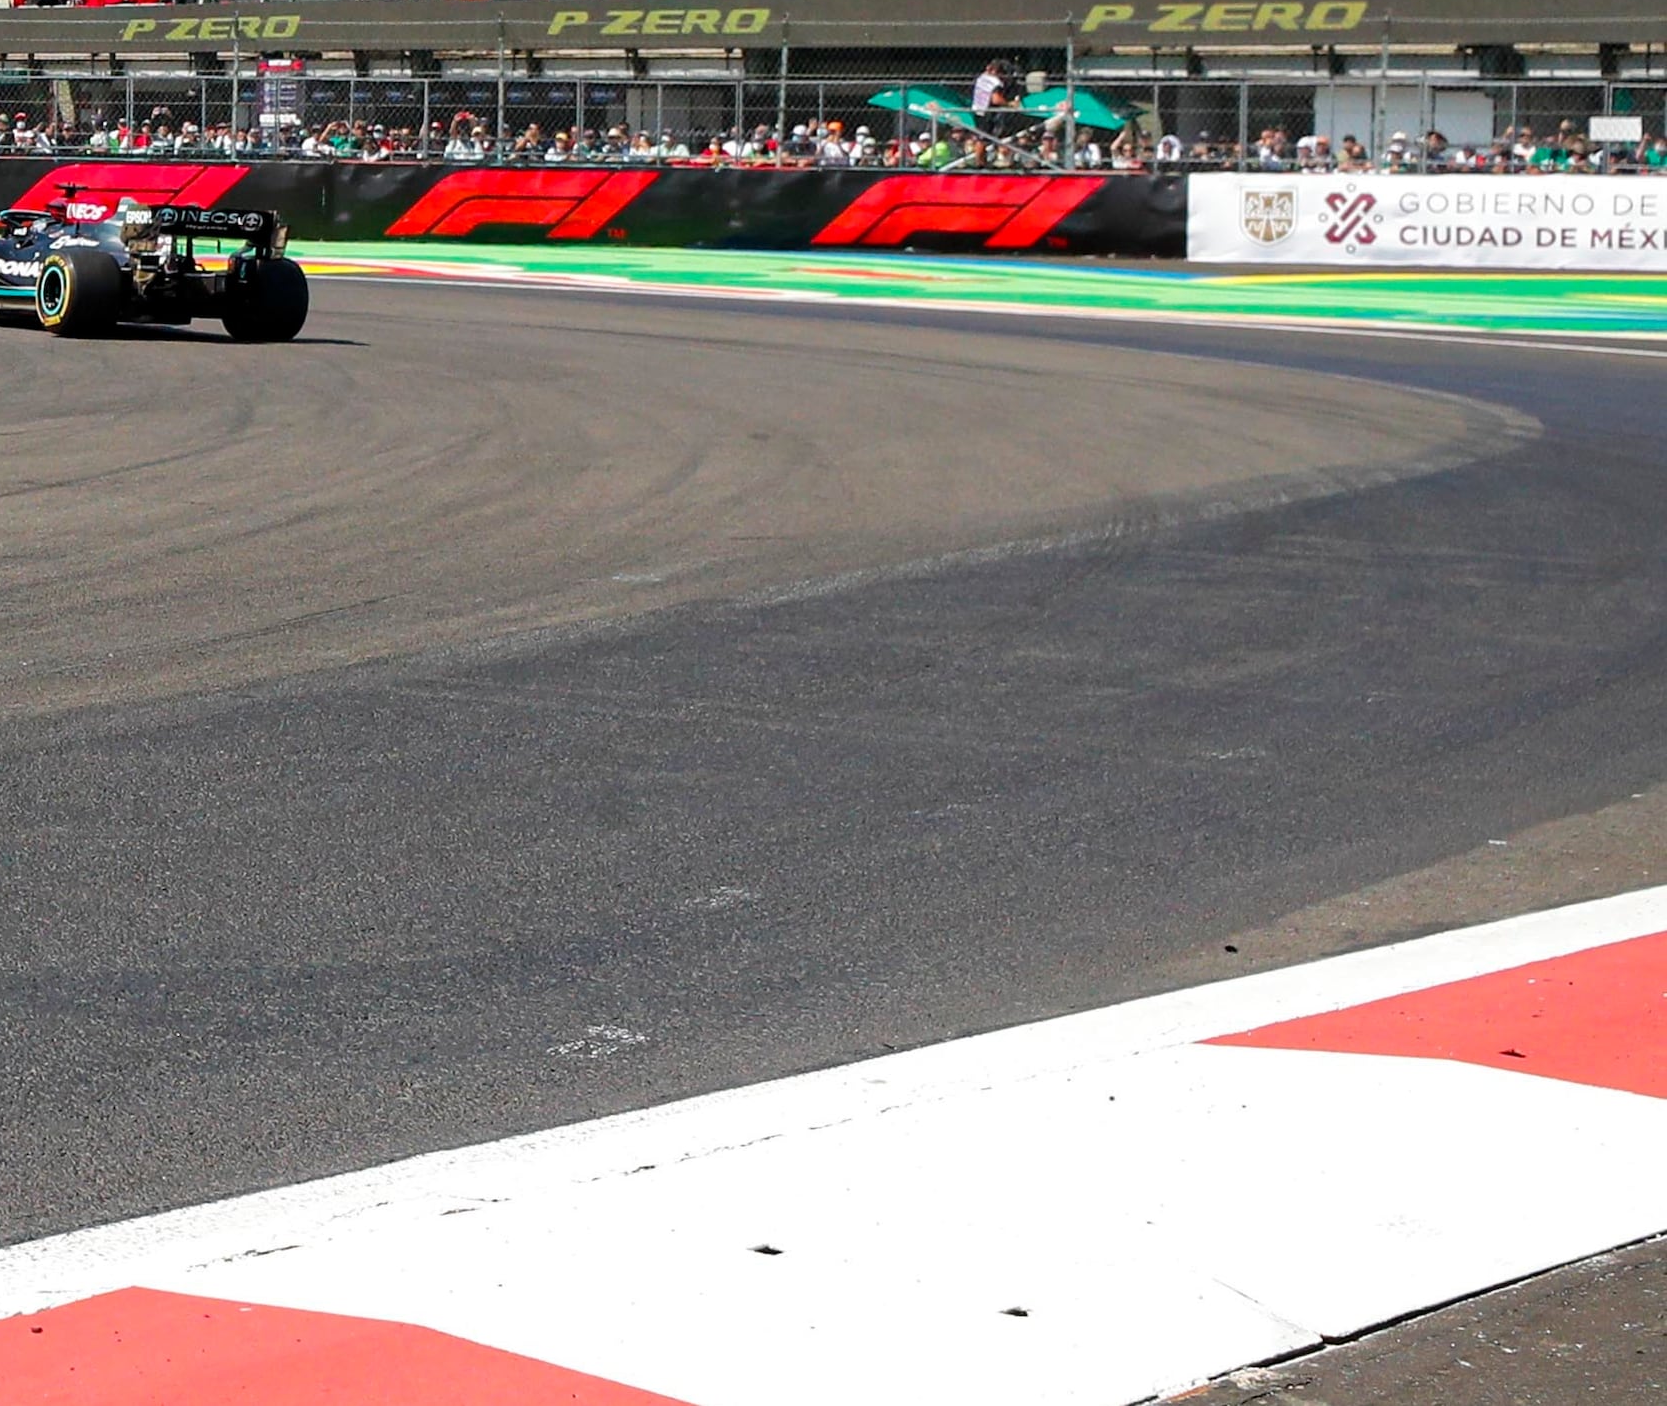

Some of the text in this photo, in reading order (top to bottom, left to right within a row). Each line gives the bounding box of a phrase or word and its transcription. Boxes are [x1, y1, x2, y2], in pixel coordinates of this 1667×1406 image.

[122, 14, 303, 41] P ZERO
[546, 6, 772, 37] P ZERO
[1080, 1, 1134, 34] P
[66, 202, 107, 220] INEOS
[1399, 192, 1658, 216] GOBIERNO DE
[180, 210, 239, 225] INEOS
[1399, 224, 1523, 247] CIUDAD
[1536, 226, 1577, 249] DE
